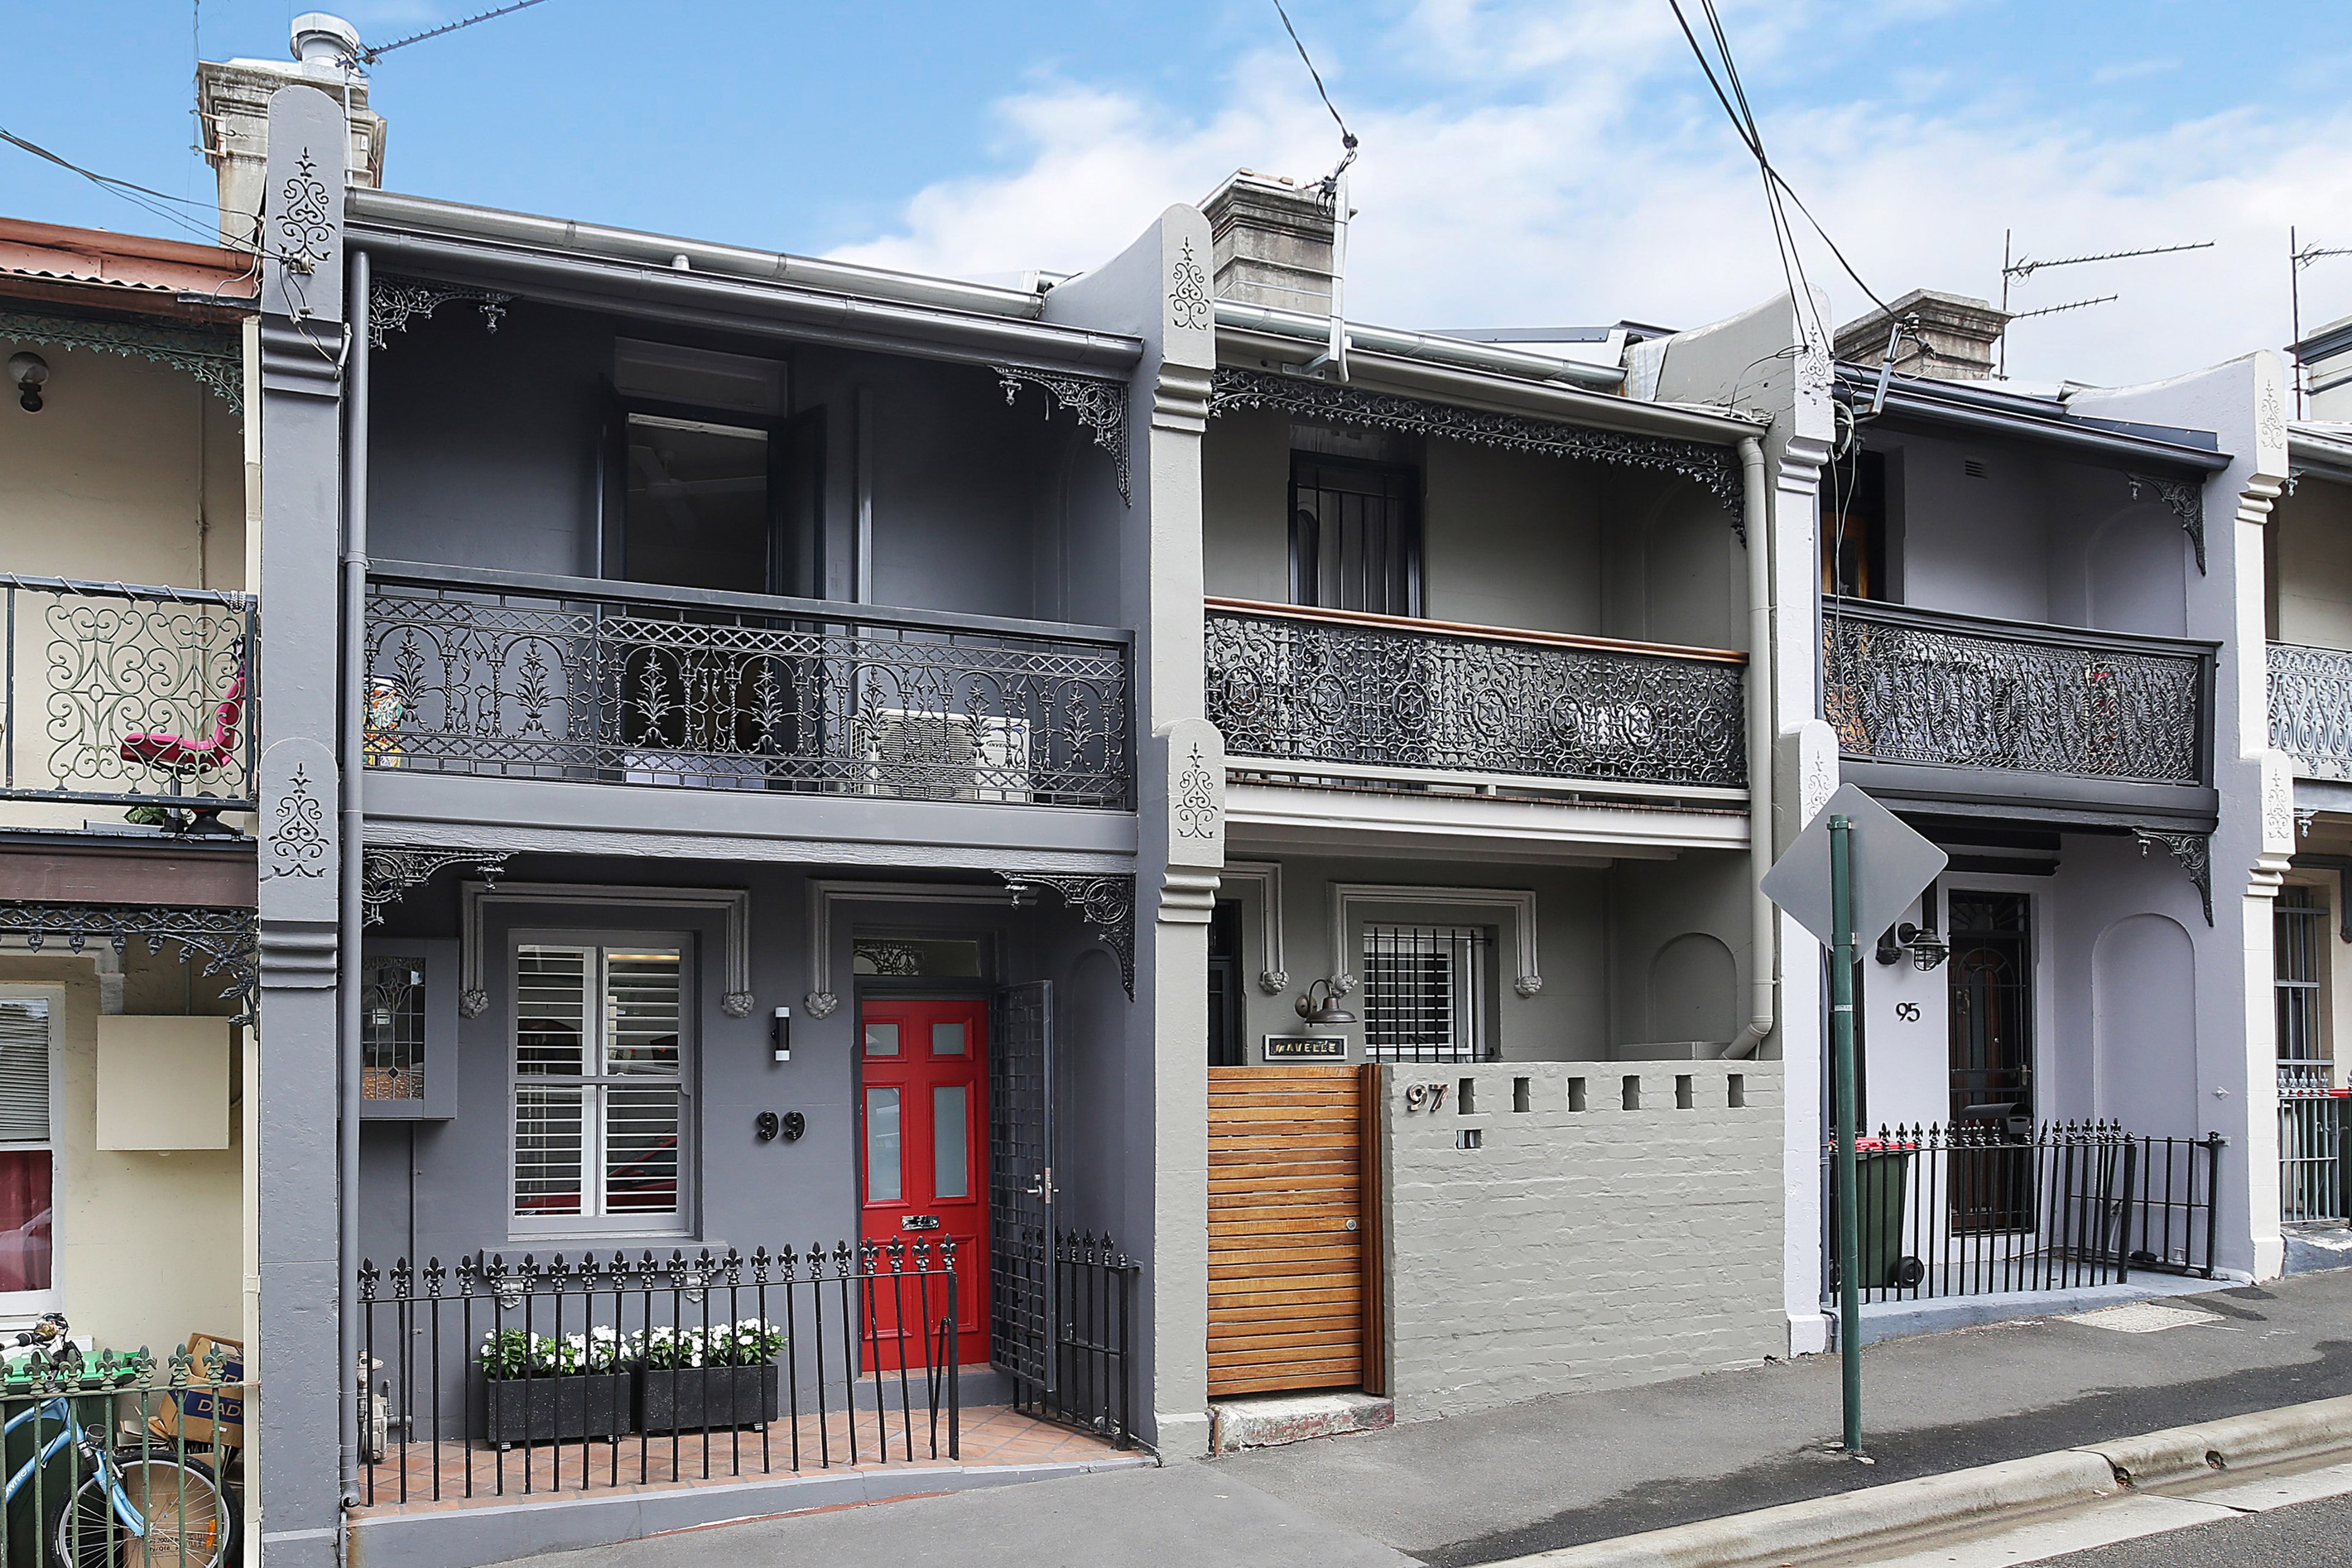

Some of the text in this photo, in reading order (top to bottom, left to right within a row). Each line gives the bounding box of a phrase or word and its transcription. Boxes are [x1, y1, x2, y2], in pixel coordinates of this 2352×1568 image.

[1896, 1002, 1921, 1022] 95
[1406, 1084, 1450, 1112] 97
[758, 1110, 806, 1141] 99
[197, 1399, 243, 1418] DAD
